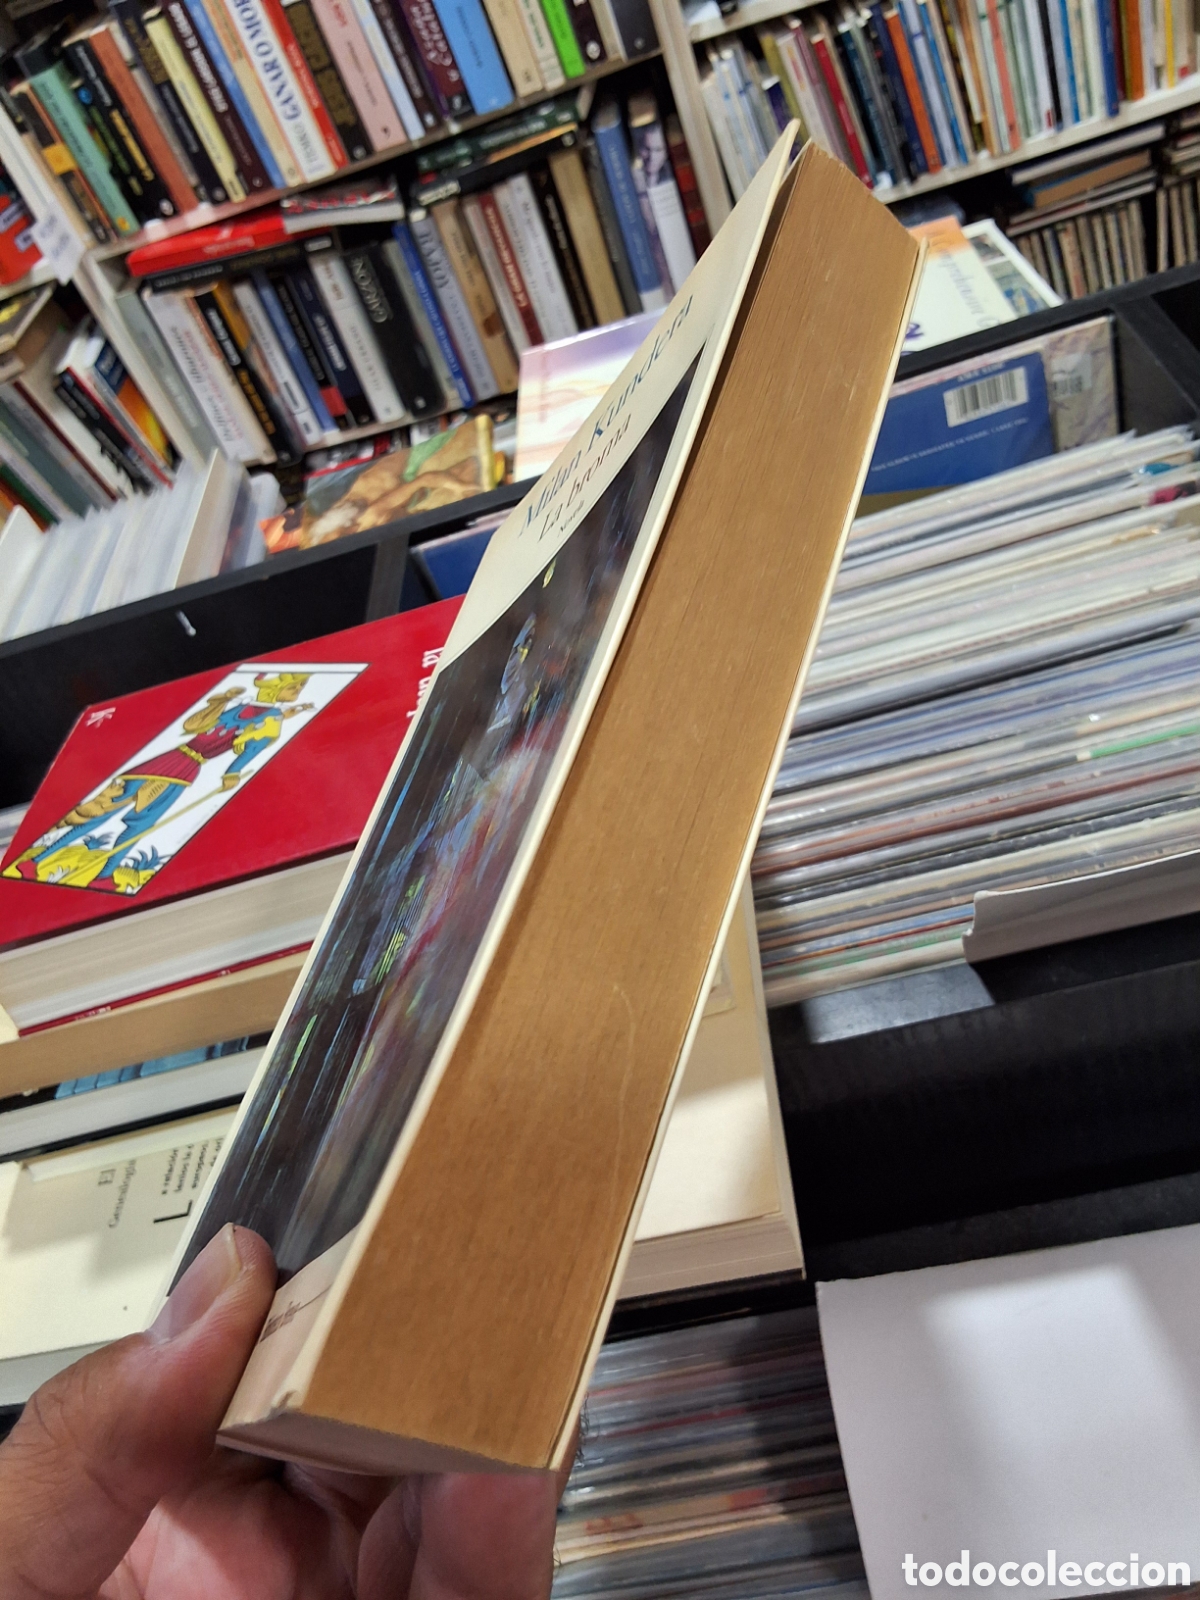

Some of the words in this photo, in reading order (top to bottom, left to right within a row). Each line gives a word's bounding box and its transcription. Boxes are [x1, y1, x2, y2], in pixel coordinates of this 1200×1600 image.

[251, 39, 273, 59] O
[257, 57, 305, 123] GANAR
[518, 449, 583, 537] Milan
[587, 294, 693, 452] Kundera
[538, 505, 568, 542] La
[569, 413, 631, 508] broma
